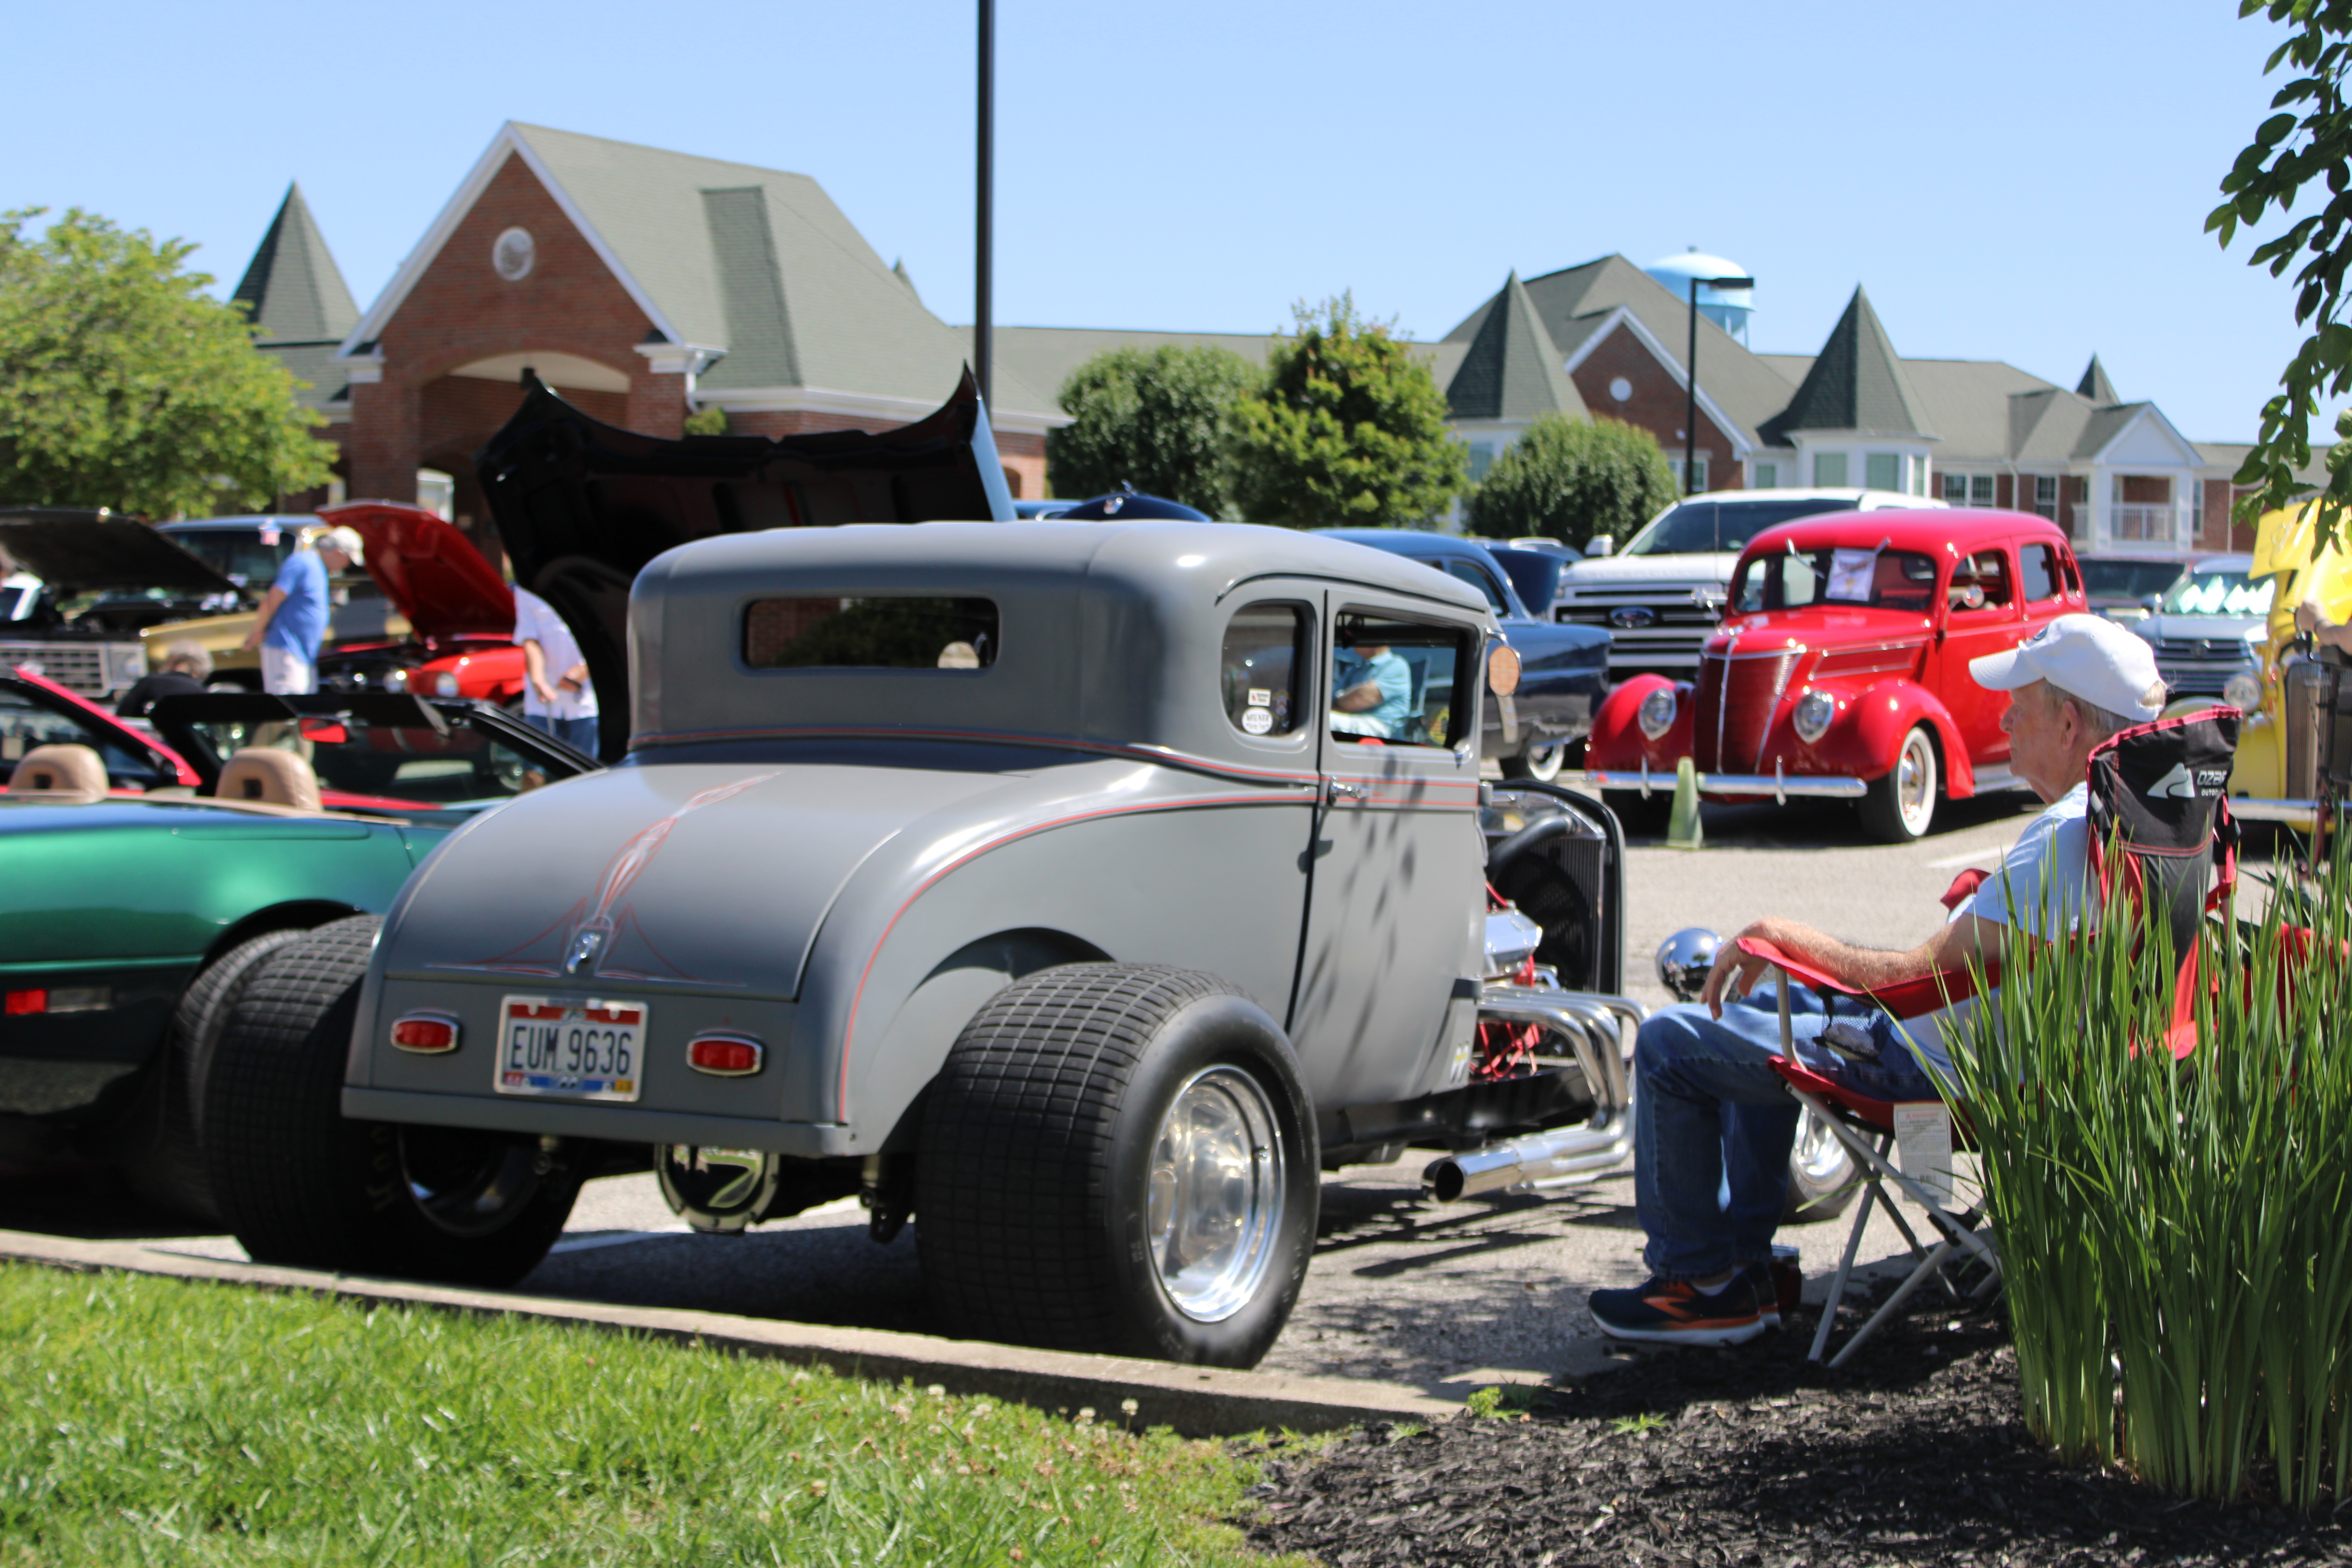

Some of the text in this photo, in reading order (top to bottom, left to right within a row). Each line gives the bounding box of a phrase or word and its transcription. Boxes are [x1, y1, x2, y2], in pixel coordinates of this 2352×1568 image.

[2197, 769, 2227, 786] OZAR
[511, 1026, 632, 1075] EUM 9636
